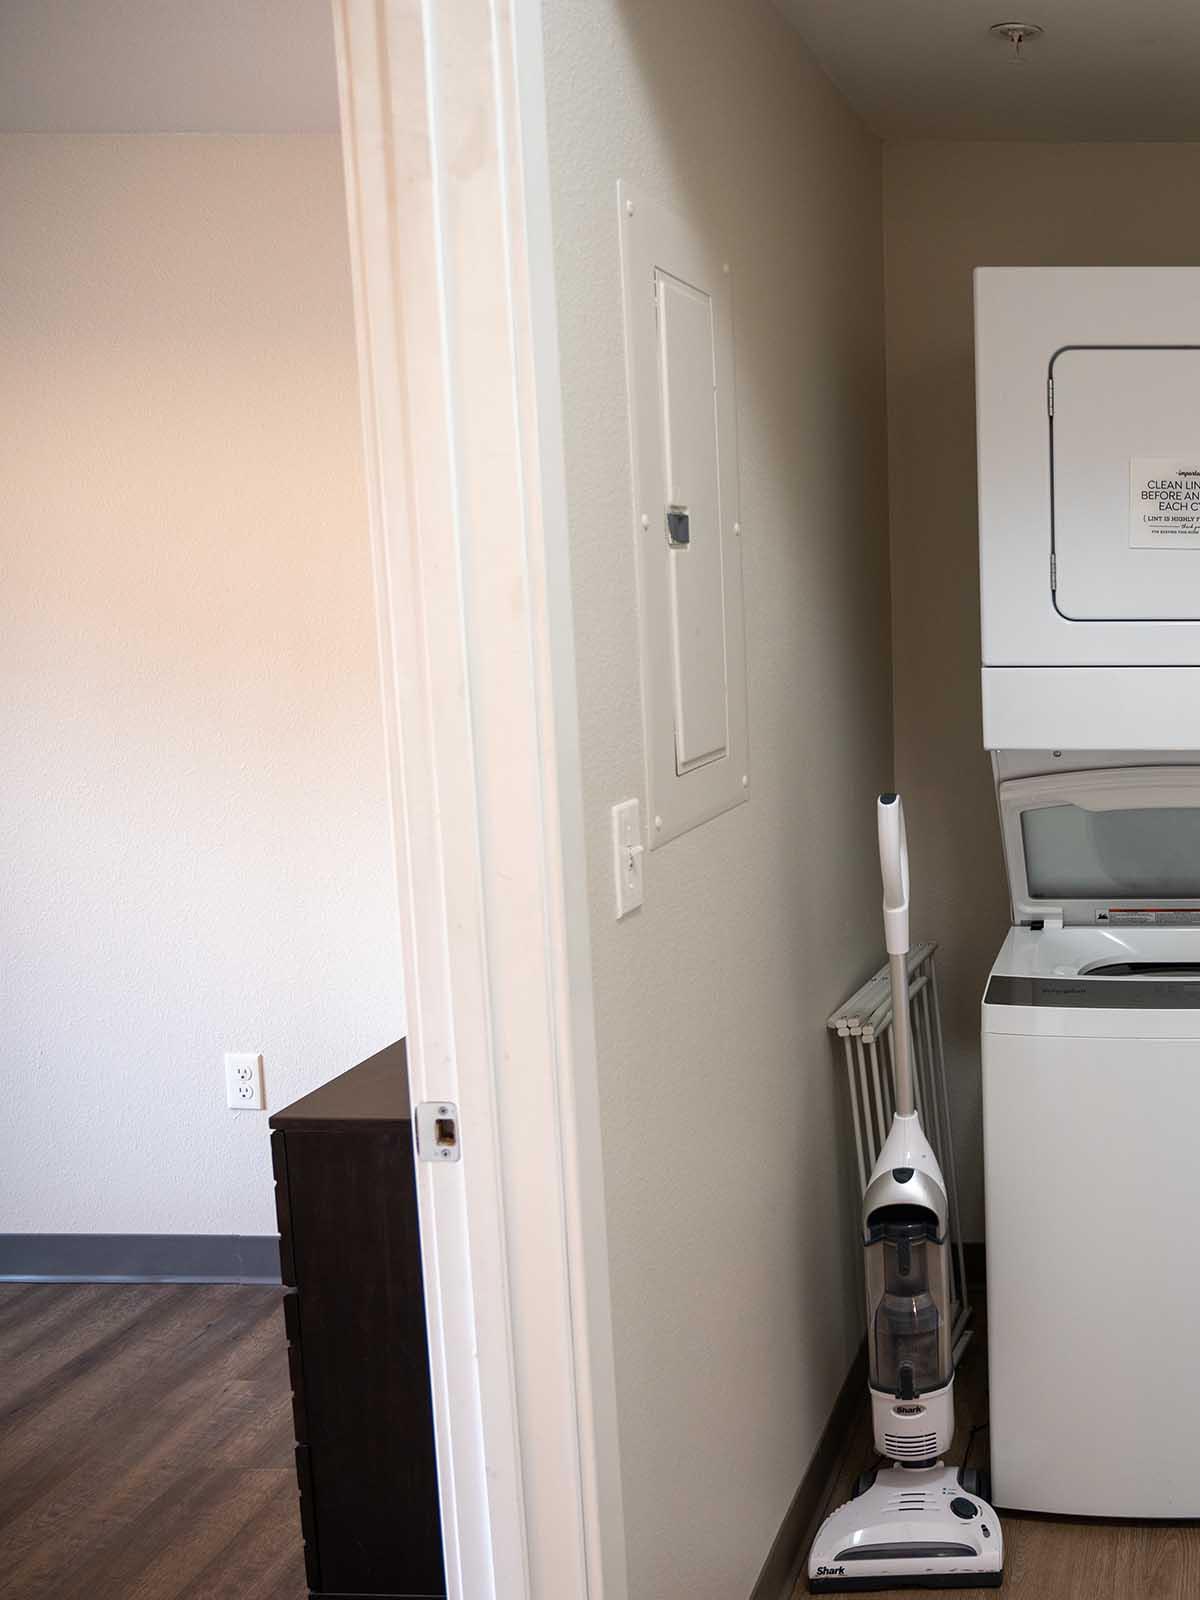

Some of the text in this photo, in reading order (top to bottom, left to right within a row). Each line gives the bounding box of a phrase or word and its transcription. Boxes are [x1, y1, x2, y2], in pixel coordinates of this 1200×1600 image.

[1147, 480, 1182, 490] CLEAN
[1141, 490, 1182, 500] BEFORE
[1158, 502, 1188, 511] EACH
[896, 1405, 922, 1415] Shark
[816, 1566, 846, 1576] Shark
